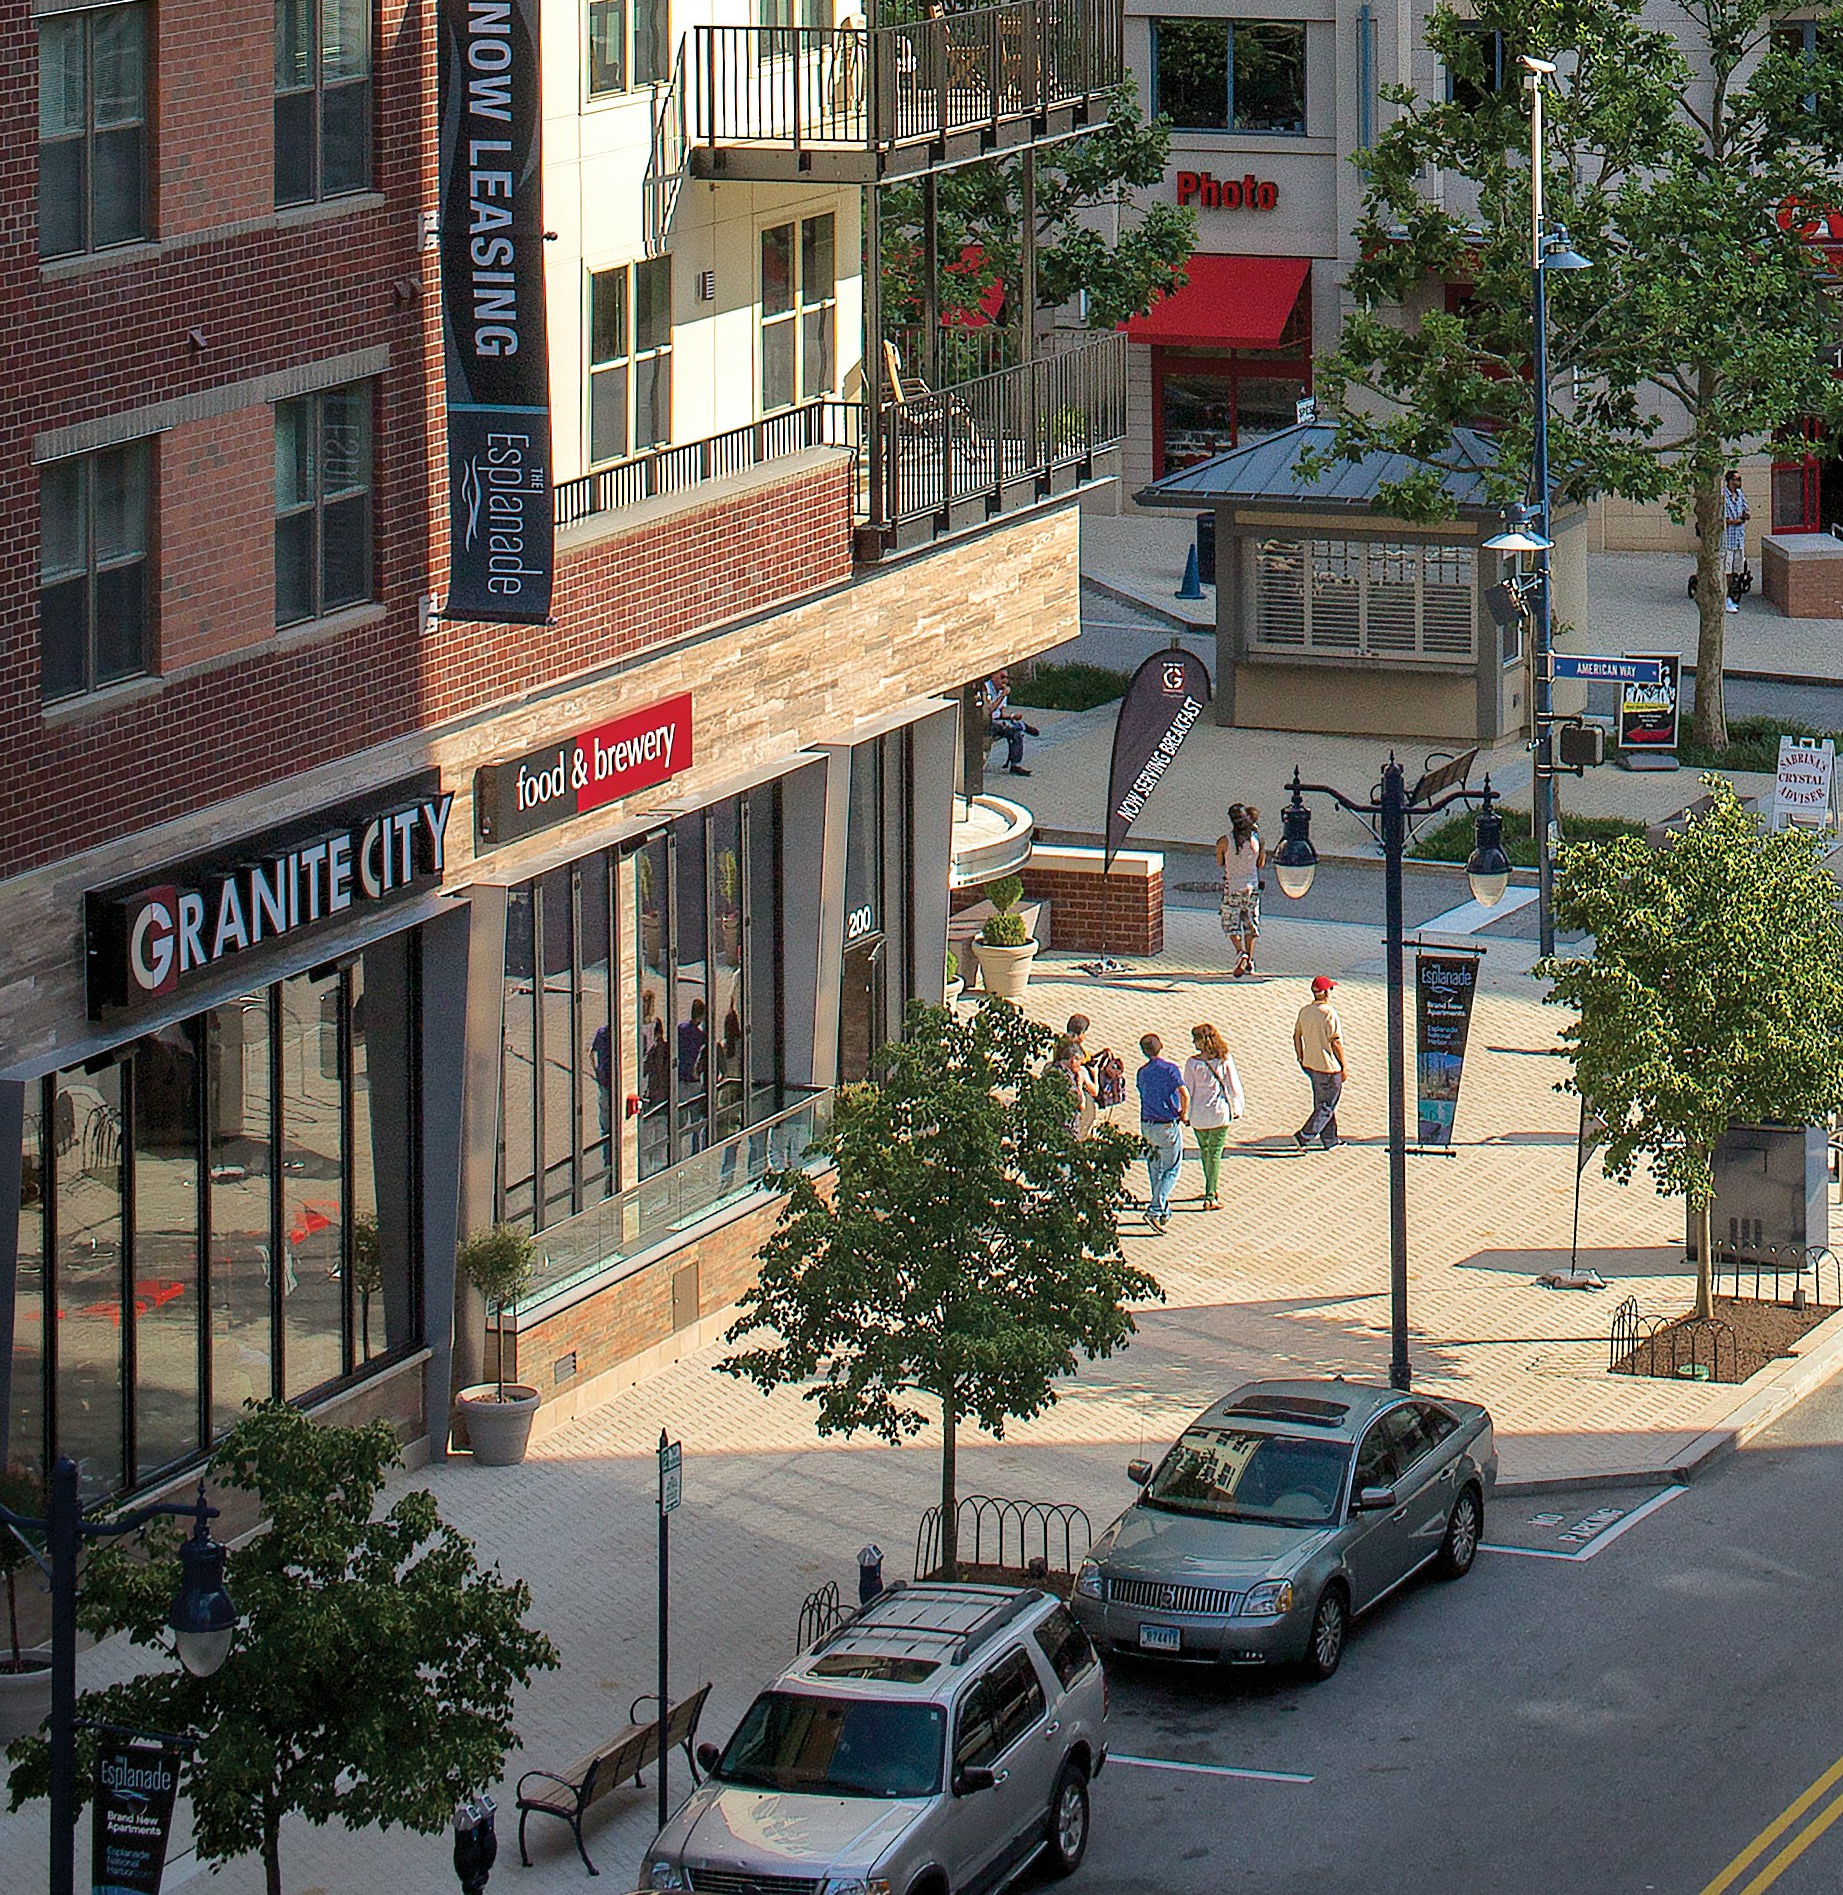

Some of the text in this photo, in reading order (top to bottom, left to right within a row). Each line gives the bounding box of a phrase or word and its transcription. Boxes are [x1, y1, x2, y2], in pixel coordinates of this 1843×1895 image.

[467, 2, 519, 356] NOW LEASING
[1177, 171, 1279, 210] Photo
[530, 466, 544, 489] THE
[477, 433, 544, 595] Esplanade
[1576, 662, 1637, 678] AMERICAN WAY
[516, 723, 676, 811] food & brewery
[1116, 790, 1145, 823] NOW
[1133, 749, 1172, 798] SERVING
[1158, 695, 1204, 757] BREAKFAST
[1778, 772, 1825, 785] CRYSTAL
[1779, 786, 1825, 804] ADVISER
[131, 794, 453, 990] GRANITE CITY
[848, 905, 872, 939] 200
[1421, 964, 1472, 987] Esplanade
[101, 1757, 171, 1791] Esplanade
[107, 1811, 158, 1826] Brand New
[107, 1821, 162, 1835] Apartments
